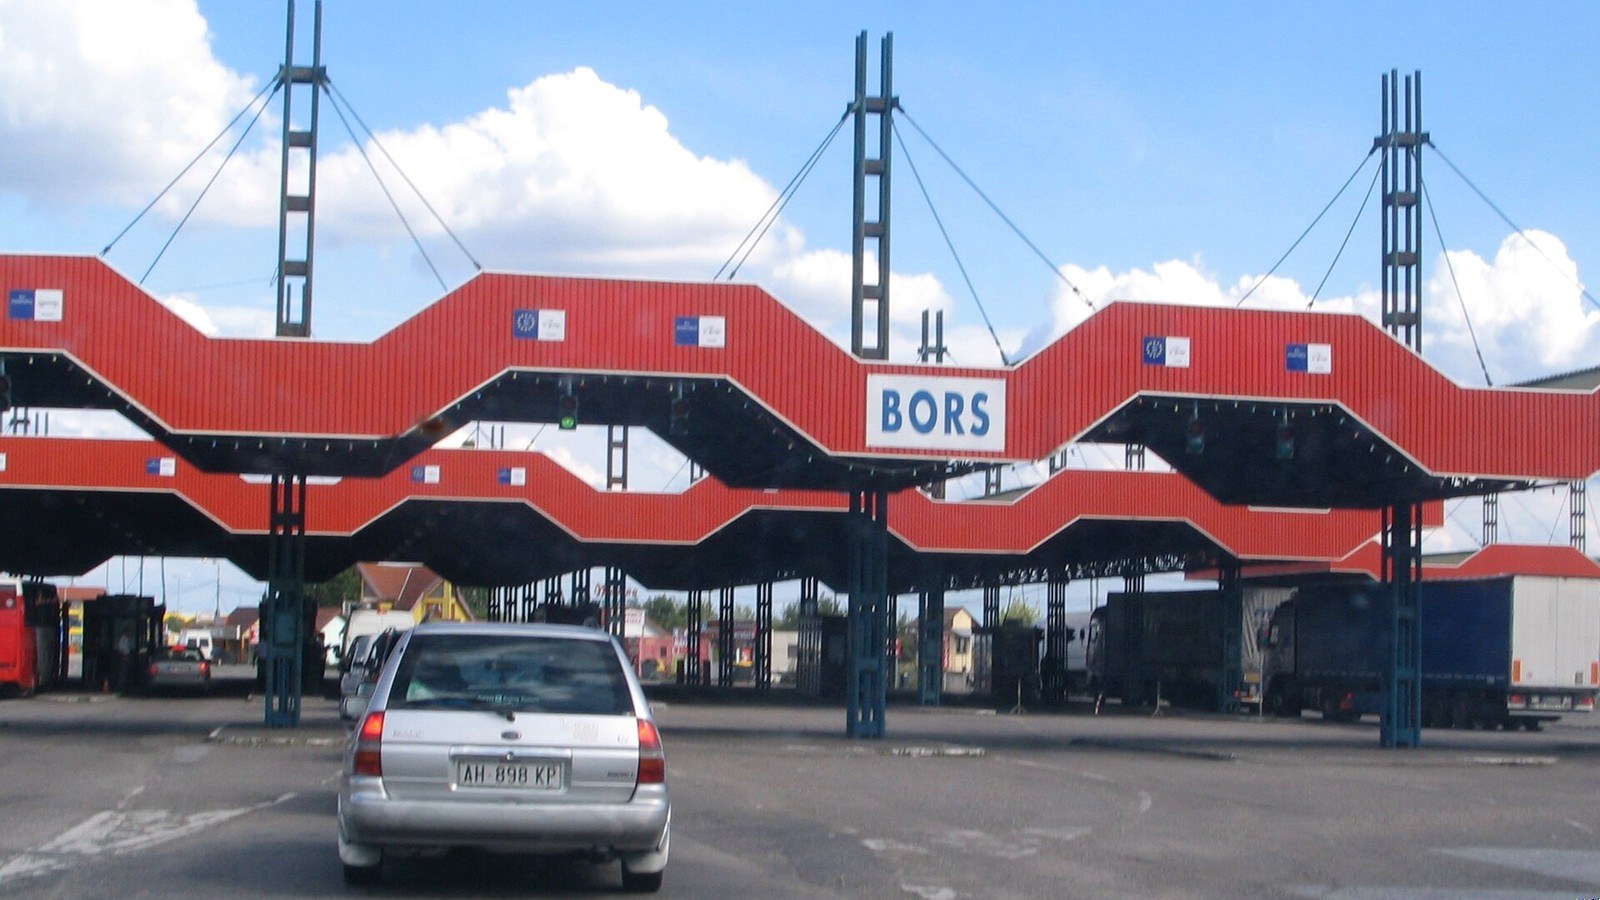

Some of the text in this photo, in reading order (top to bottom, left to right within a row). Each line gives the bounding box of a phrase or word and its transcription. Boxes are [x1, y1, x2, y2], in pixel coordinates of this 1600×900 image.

[881, 389, 990, 437] BORS
[463, 764, 557, 786] AH 898 KP
